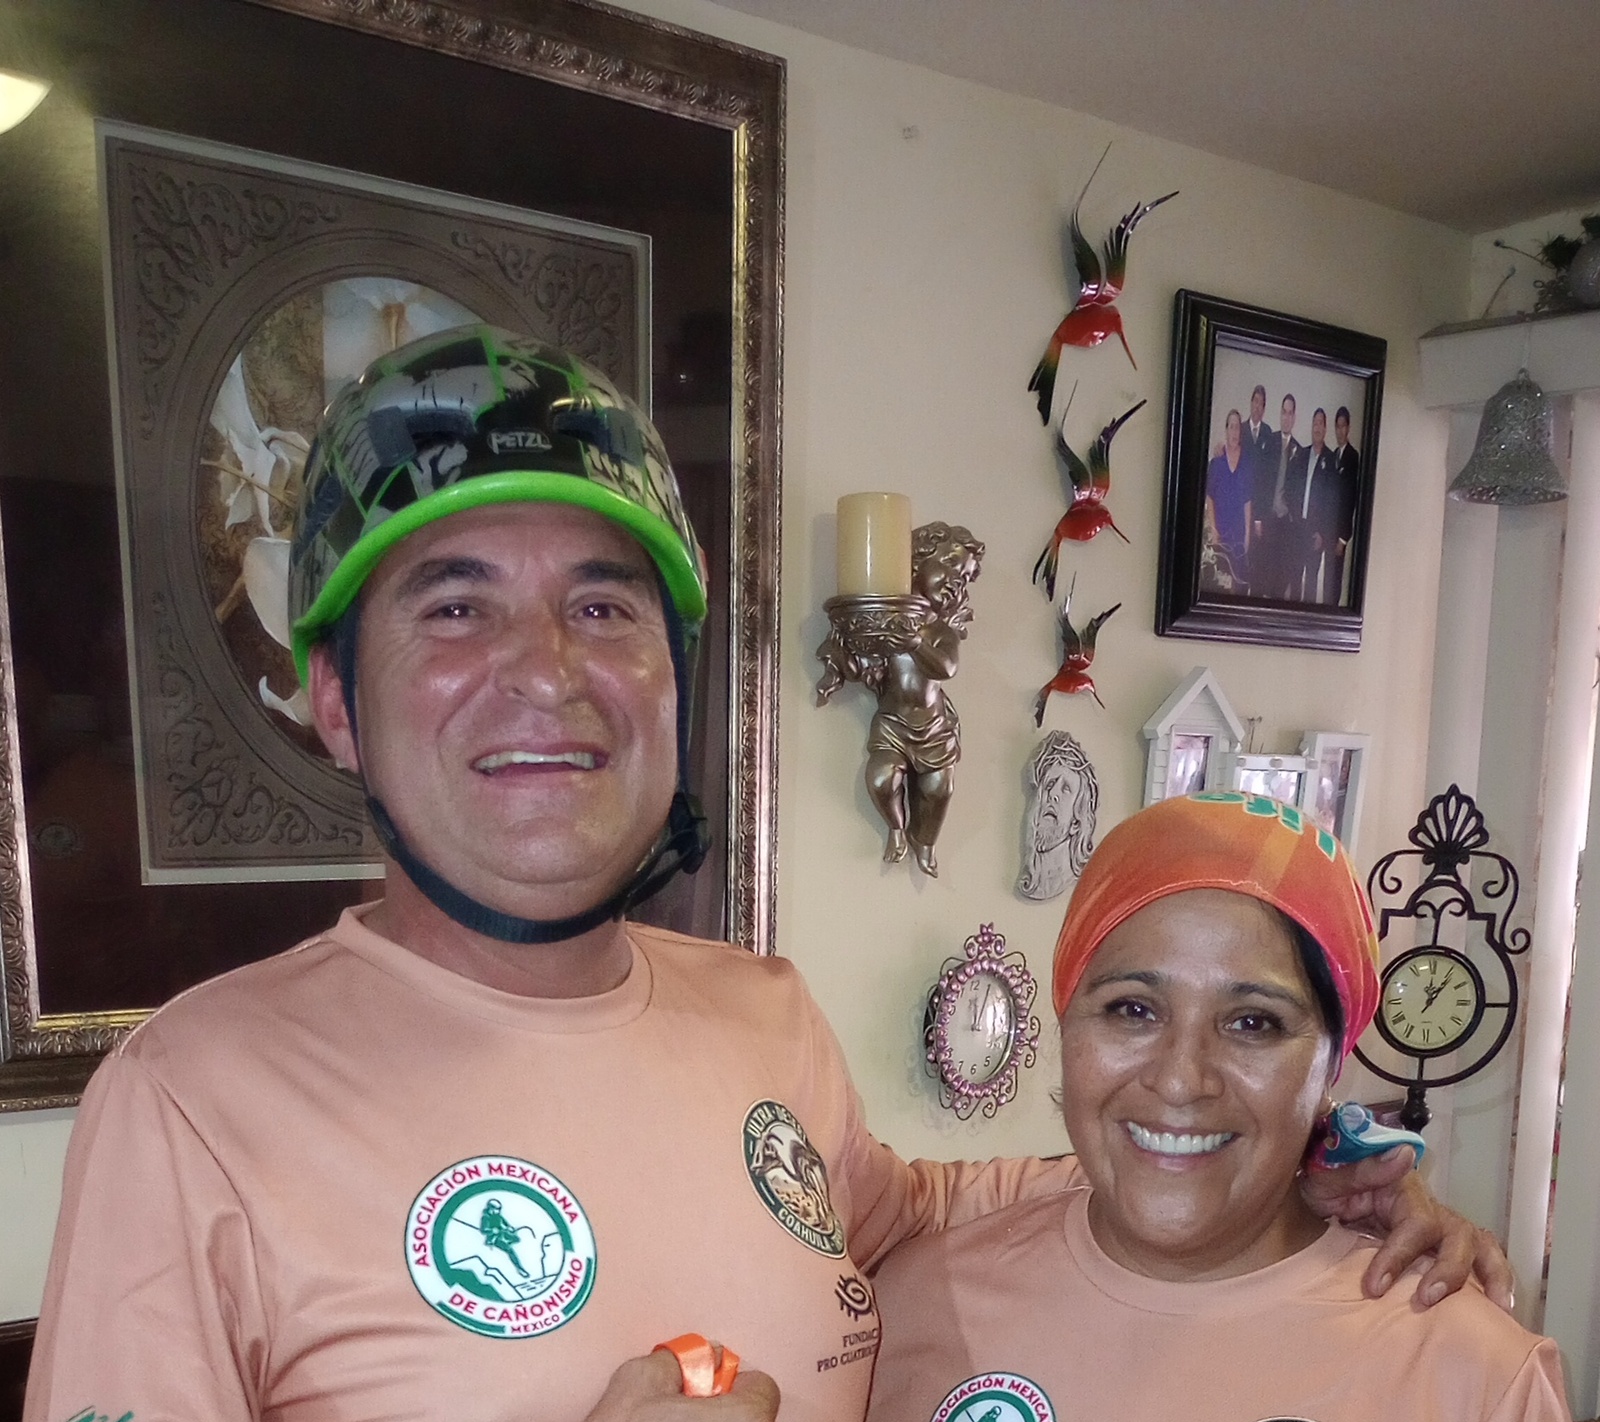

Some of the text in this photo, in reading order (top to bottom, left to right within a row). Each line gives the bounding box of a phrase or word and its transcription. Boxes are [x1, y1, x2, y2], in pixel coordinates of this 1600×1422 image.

[491, 431, 553, 455] PETZL
[970, 980, 980, 991] 12
[970, 1064, 976, 1075] 6
[984, 1056, 990, 1067] 5
[747, 1104, 775, 1138] ULTRA
[413, 1162, 580, 1268] ASOCIACIÓN MEXICANA
[448, 1258, 583, 1322] DE CAÑONISMO
[510, 1313, 561, 1334] MEXICO
[817, 1356, 838, 1373] PRO
